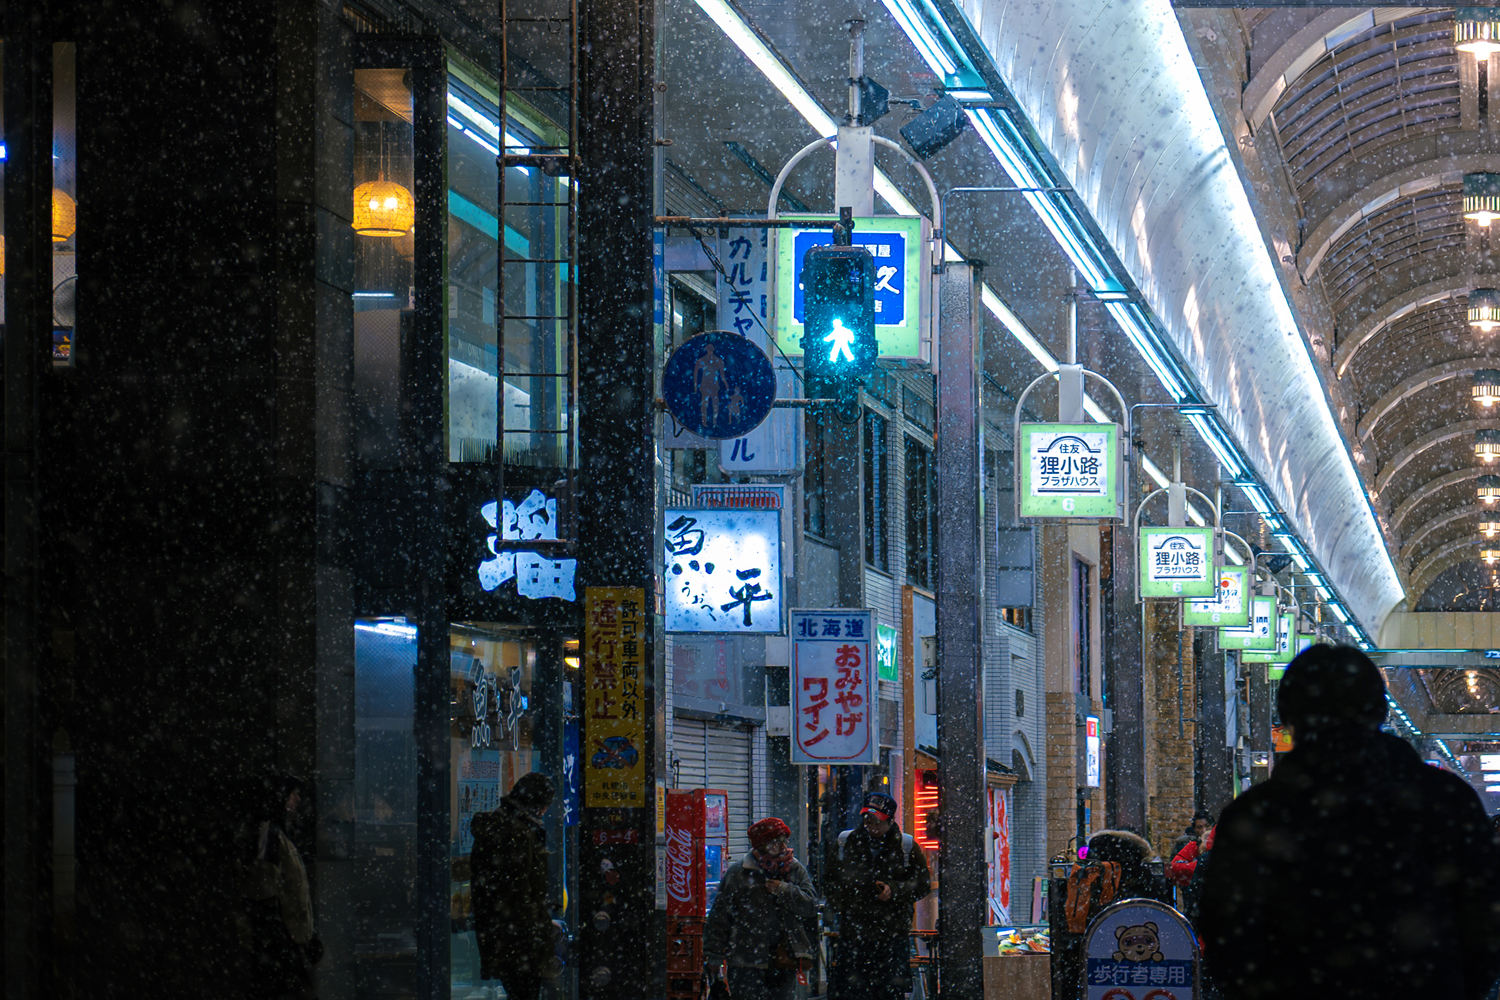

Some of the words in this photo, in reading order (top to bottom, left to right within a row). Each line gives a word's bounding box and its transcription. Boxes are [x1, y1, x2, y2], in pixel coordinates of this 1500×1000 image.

[1059, 444, 1080, 454] 住友
[1040, 456, 1099, 475] 狸小路
[1040, 476, 1099, 487] プラザハウス
[1062, 498, 1075, 512] 6
[1155, 551, 1200, 566] 狸小路
[1172, 582, 1182, 593] 6
[1211, 614, 1221, 623] 6
[798, 618, 864, 637] 北海道
[1243, 637, 1251, 647] 6
[591, 599, 618, 720] 通行禁止
[621, 599, 639, 720] 許可車両以外
[834, 644, 864, 736] おみやげ
[802, 677, 830, 747] ワイン
[1094, 965, 1185, 984] 歩行者専用
